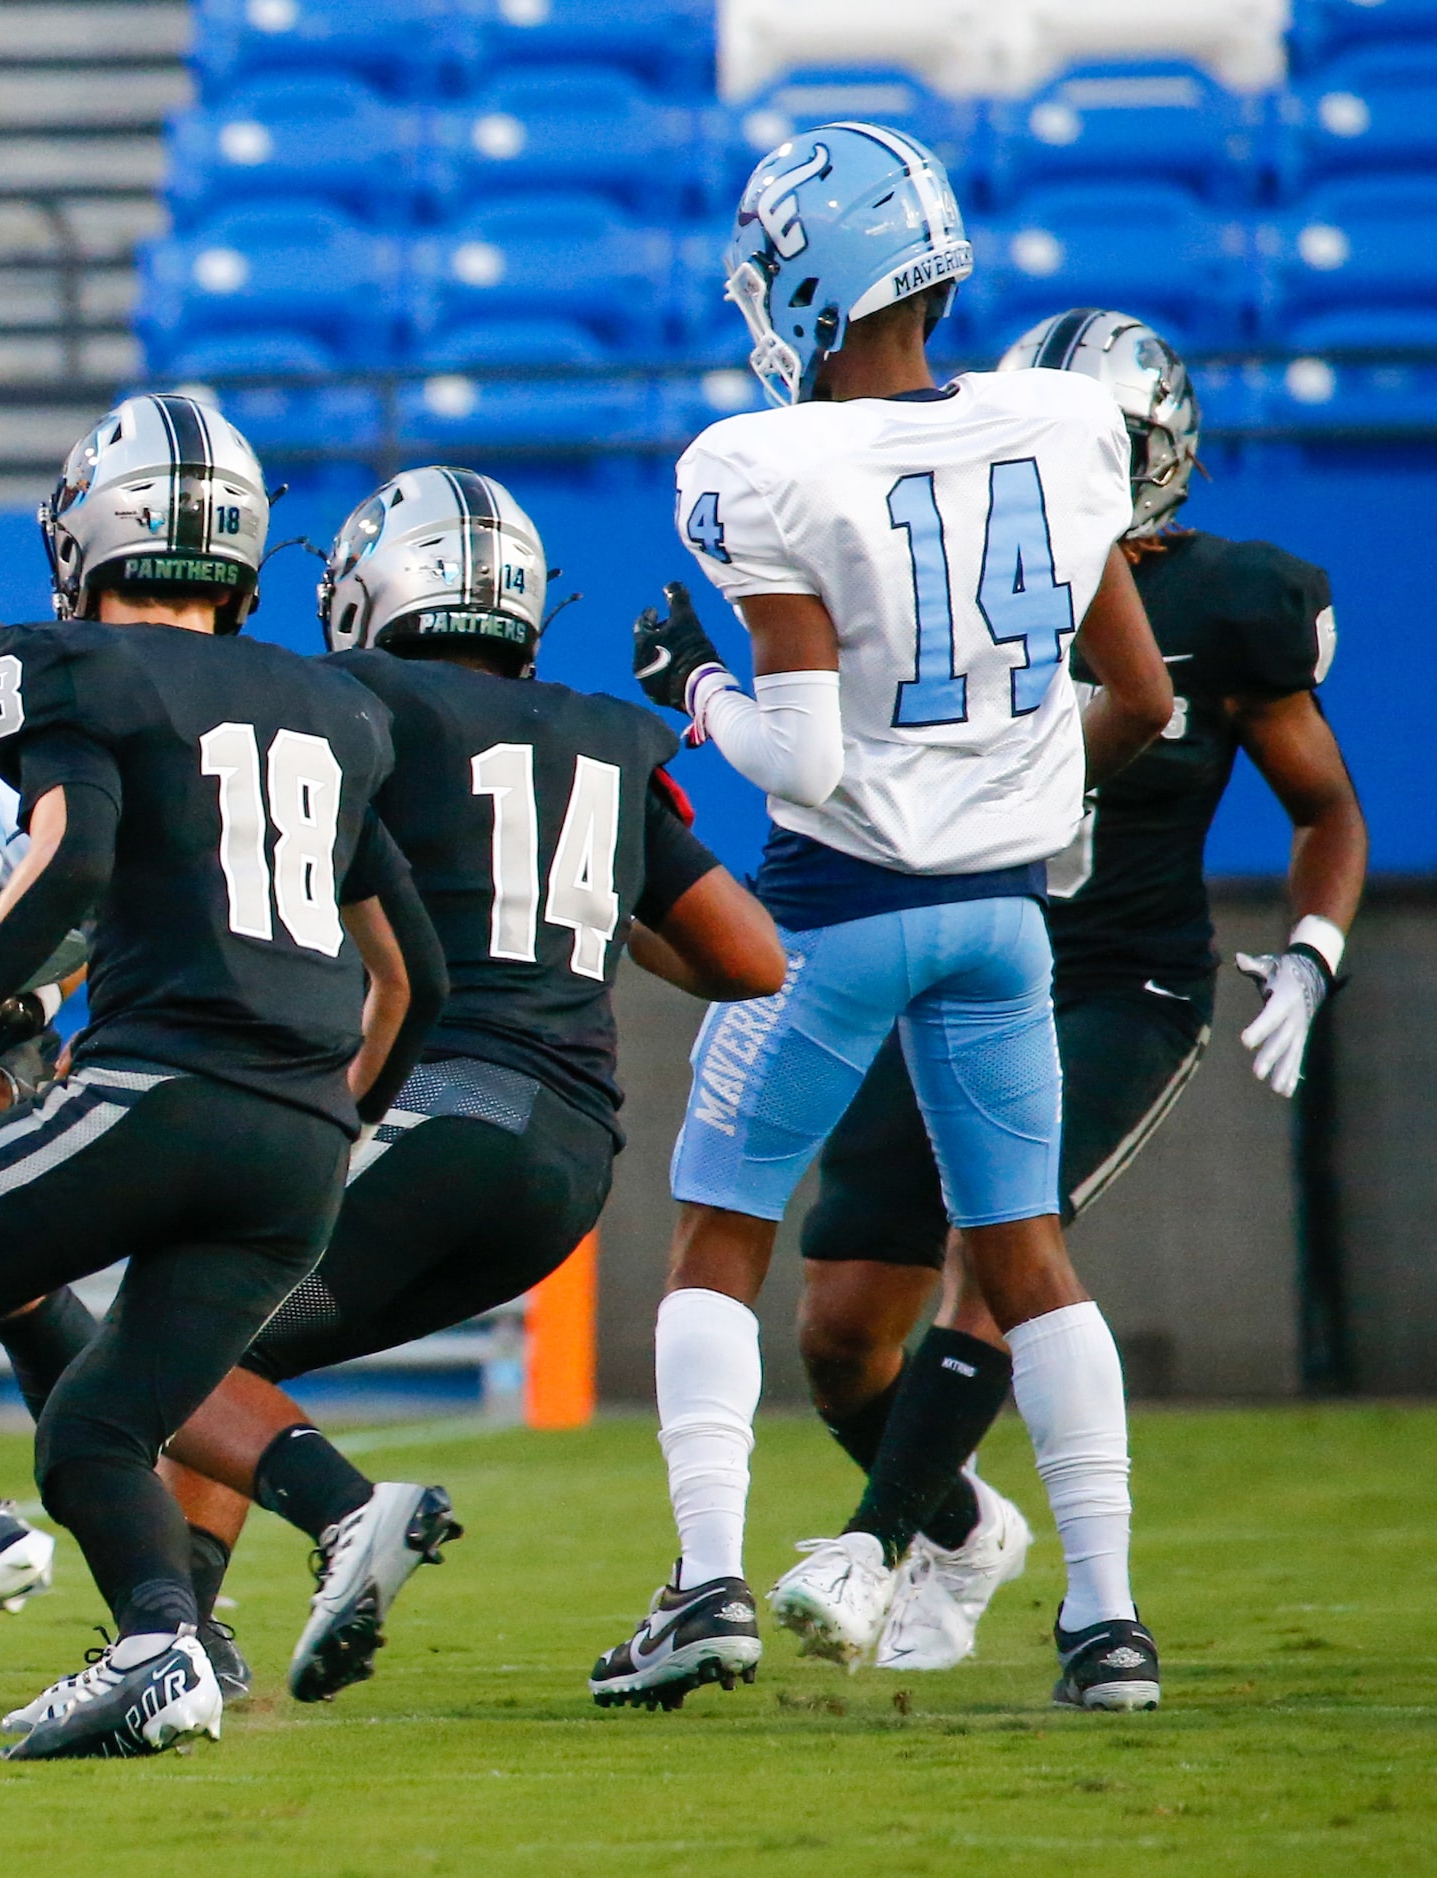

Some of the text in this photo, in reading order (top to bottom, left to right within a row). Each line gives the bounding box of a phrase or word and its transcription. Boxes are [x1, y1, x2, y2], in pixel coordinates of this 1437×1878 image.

[216, 505, 240, 535] 18
[123, 557, 239, 586] PANTHERS
[503, 562, 526, 595] 14
[886, 456, 1076, 728] 14
[417, 611, 527, 645] PANTHERS
[198, 721, 345, 958] 18
[469, 743, 621, 983] 14
